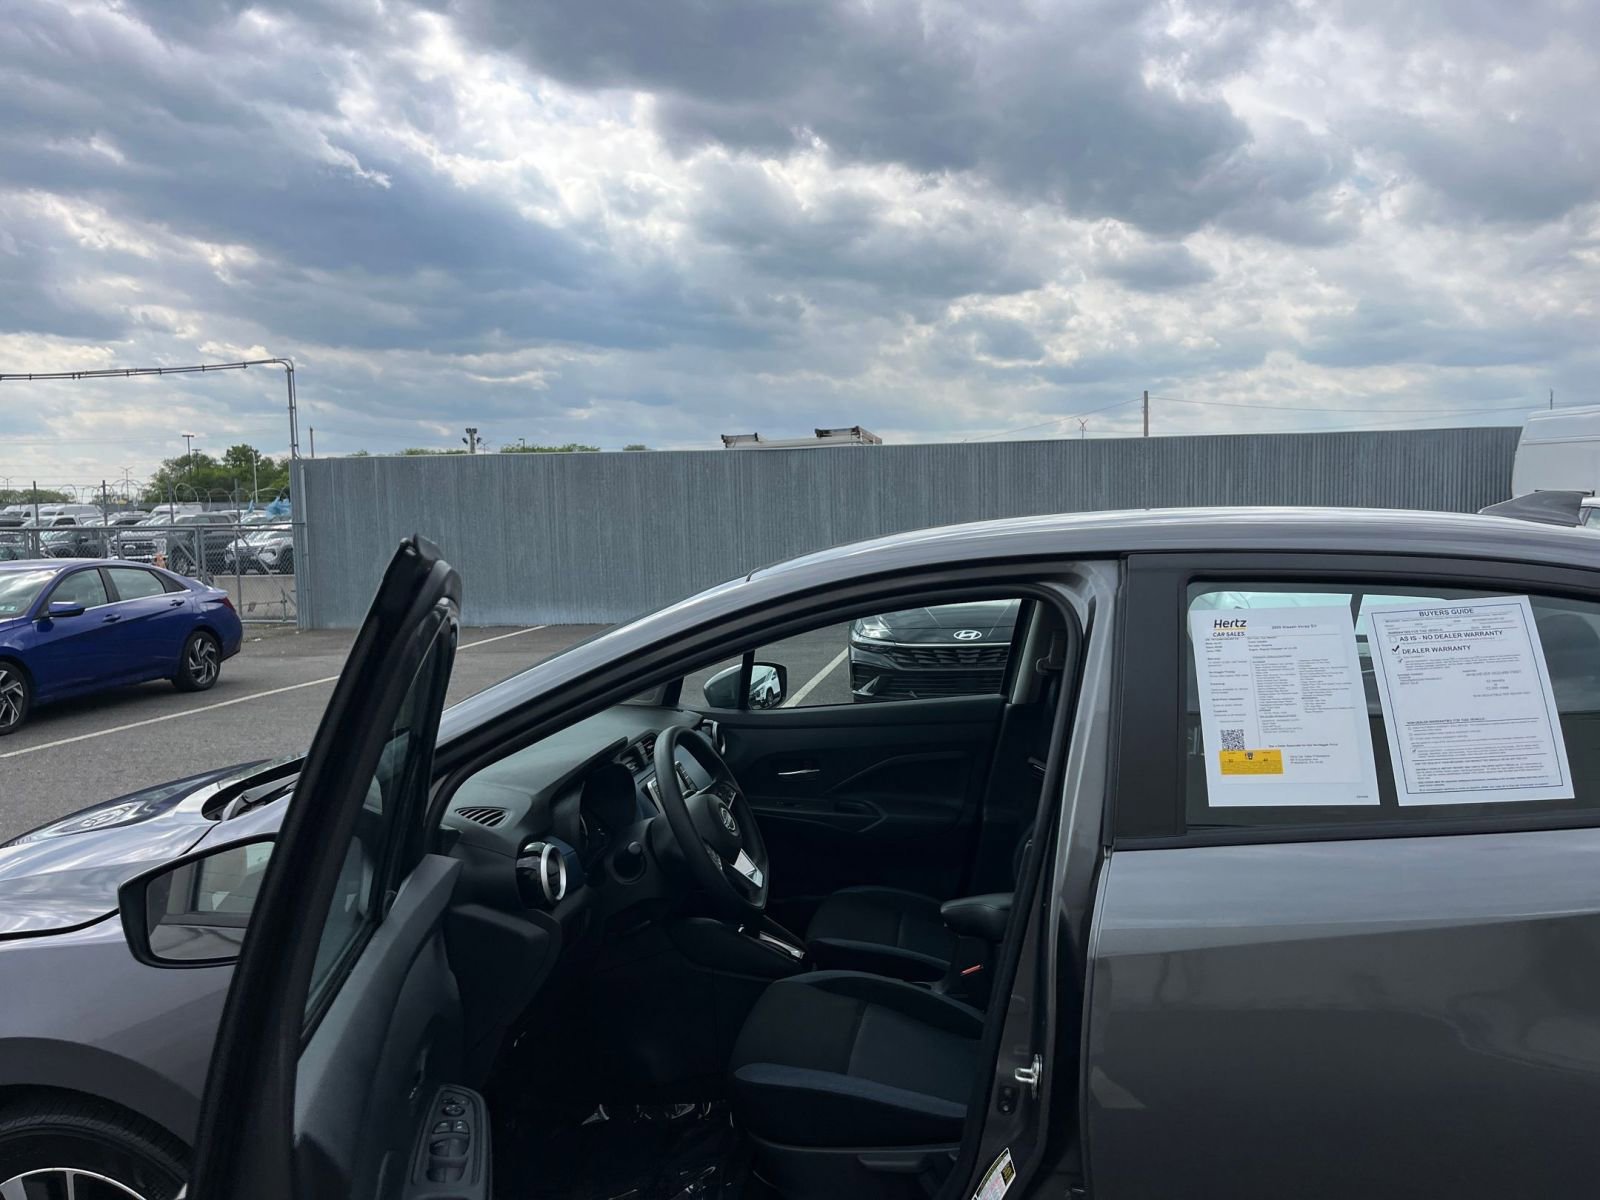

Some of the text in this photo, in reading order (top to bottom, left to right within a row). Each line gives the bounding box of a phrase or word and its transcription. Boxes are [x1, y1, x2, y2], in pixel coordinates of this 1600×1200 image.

[1419, 609, 1450, 617] BUYERS
[1213, 618, 1247, 628] Hertz
[1434, 632, 1462, 640] DEALER
[1463, 630, 1503, 638] WARRANTY
[1402, 644, 1472, 655] DEALER WARRANTY
